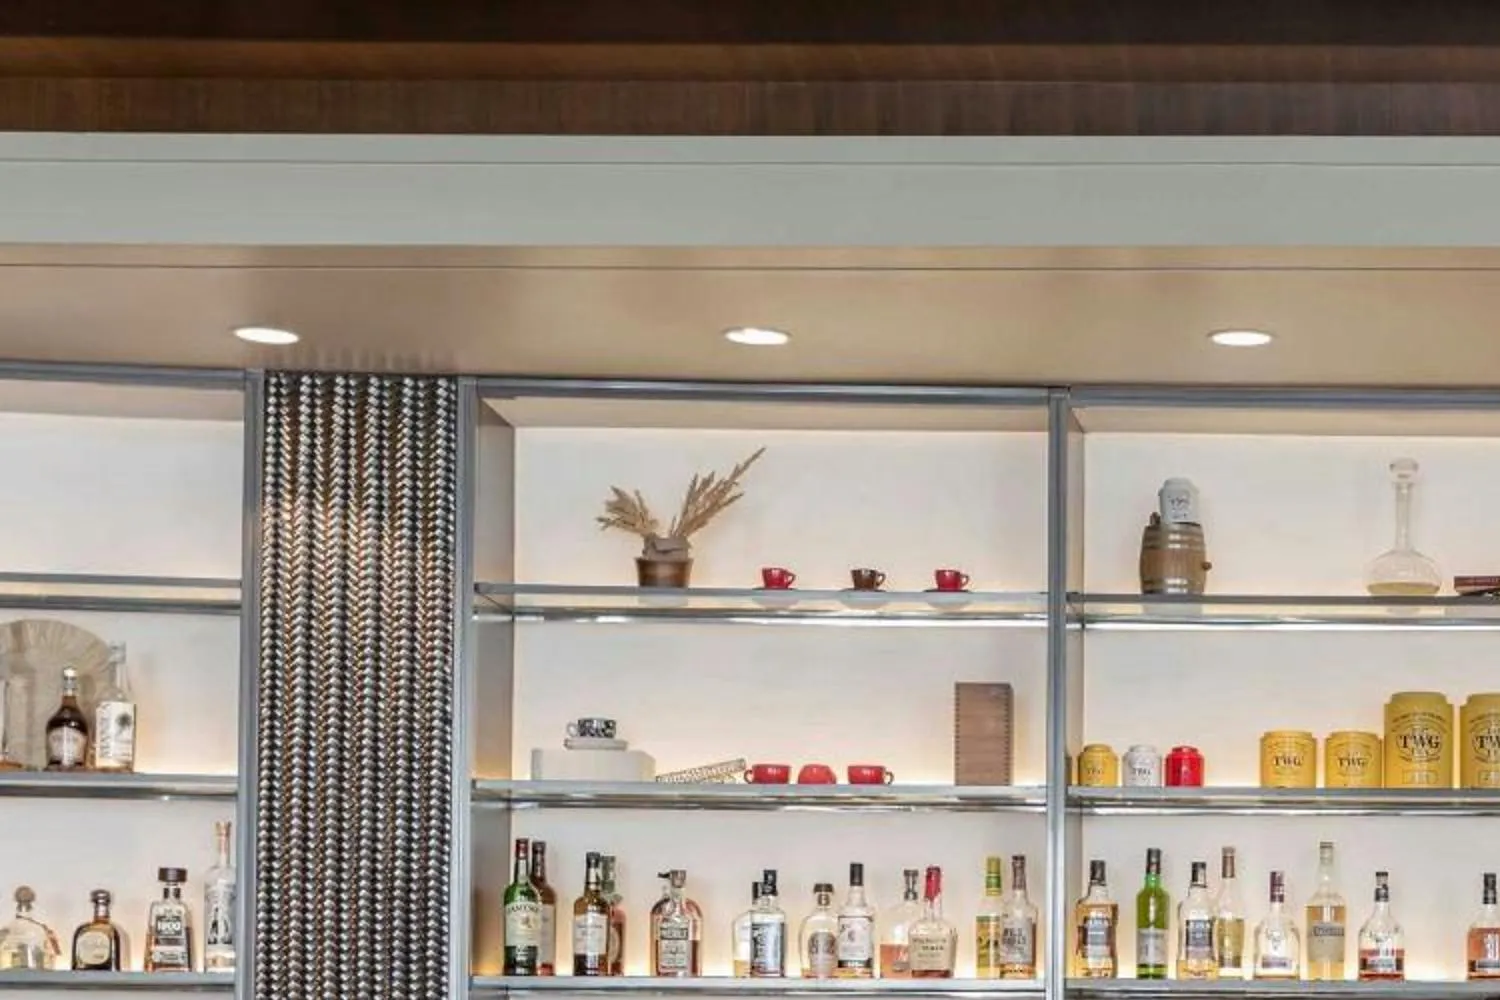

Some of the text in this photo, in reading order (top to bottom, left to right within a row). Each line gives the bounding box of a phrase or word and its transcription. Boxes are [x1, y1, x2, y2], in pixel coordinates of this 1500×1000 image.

[1399, 735, 1440, 749] TWG
[1273, 755, 1305, 767] TWG
[1336, 756, 1368, 768] TWG
